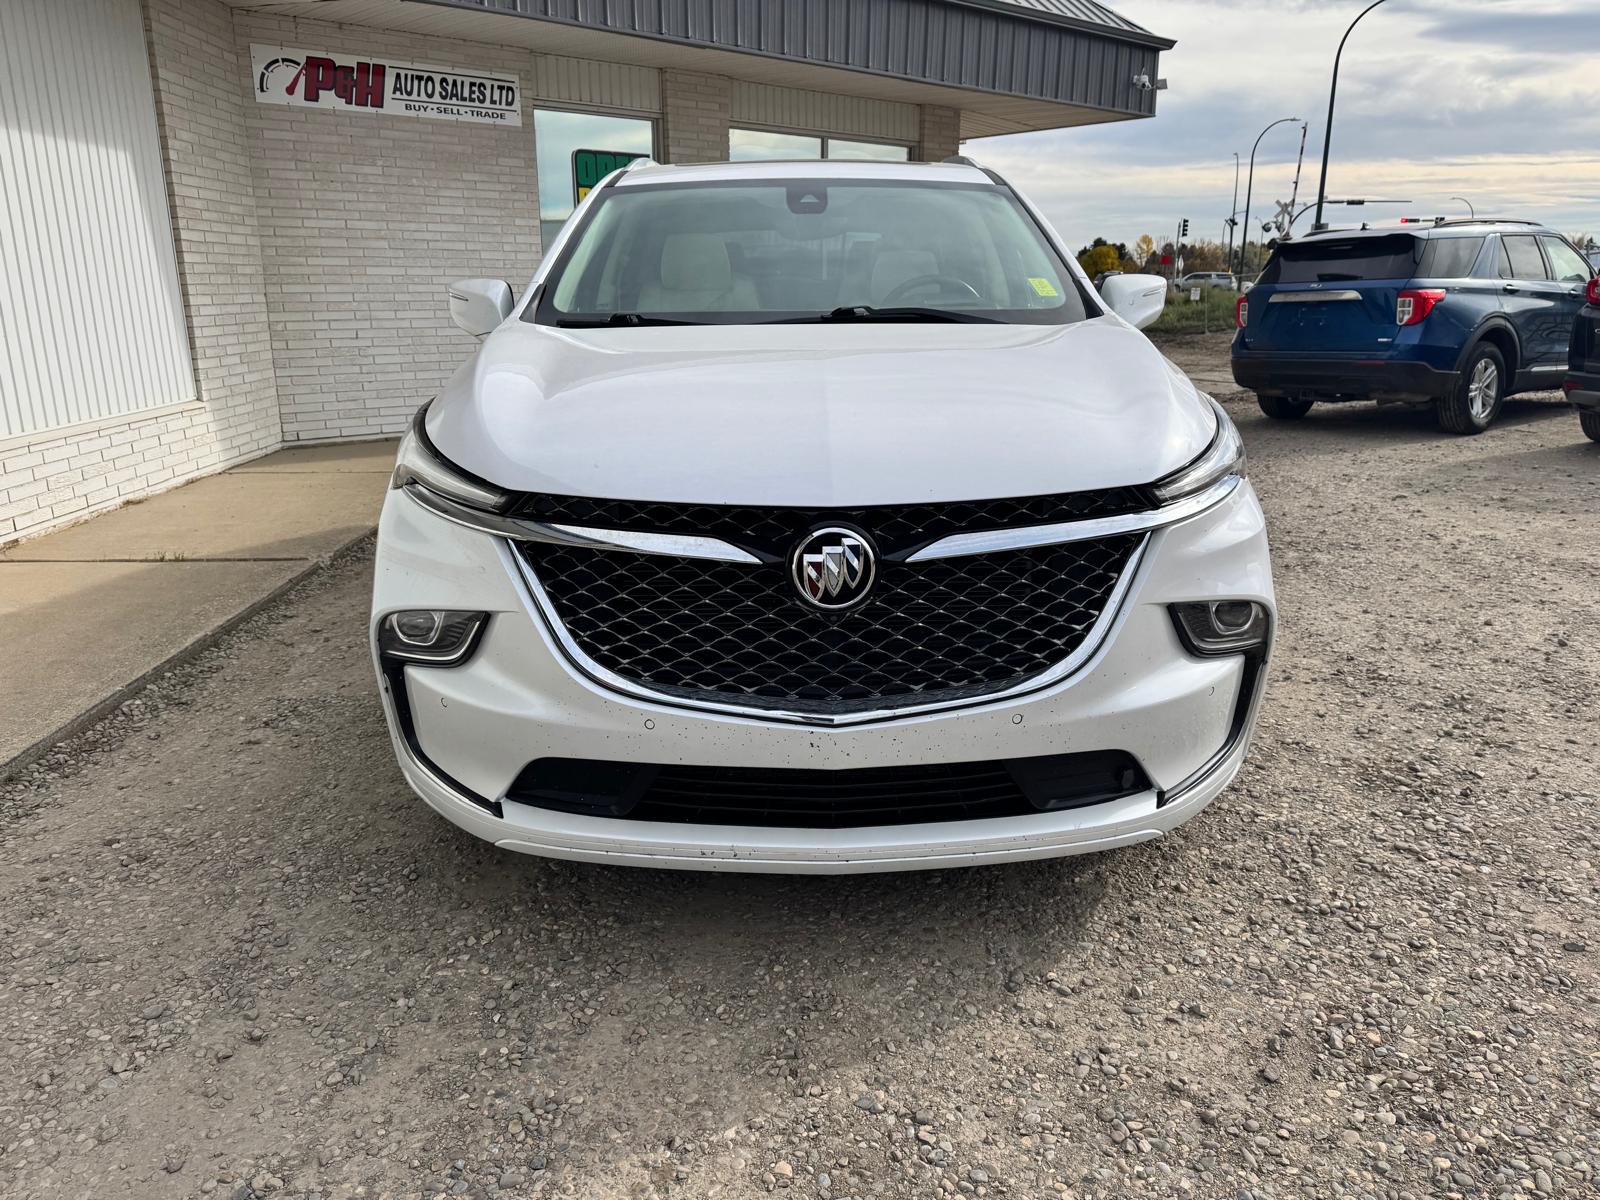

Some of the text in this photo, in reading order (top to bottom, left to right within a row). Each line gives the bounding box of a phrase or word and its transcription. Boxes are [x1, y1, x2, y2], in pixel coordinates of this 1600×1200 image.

[304, 56, 386, 108] P&H
[392, 72, 515, 107] AUTO SALES LTD
[469, 109, 506, 120] TRADE
